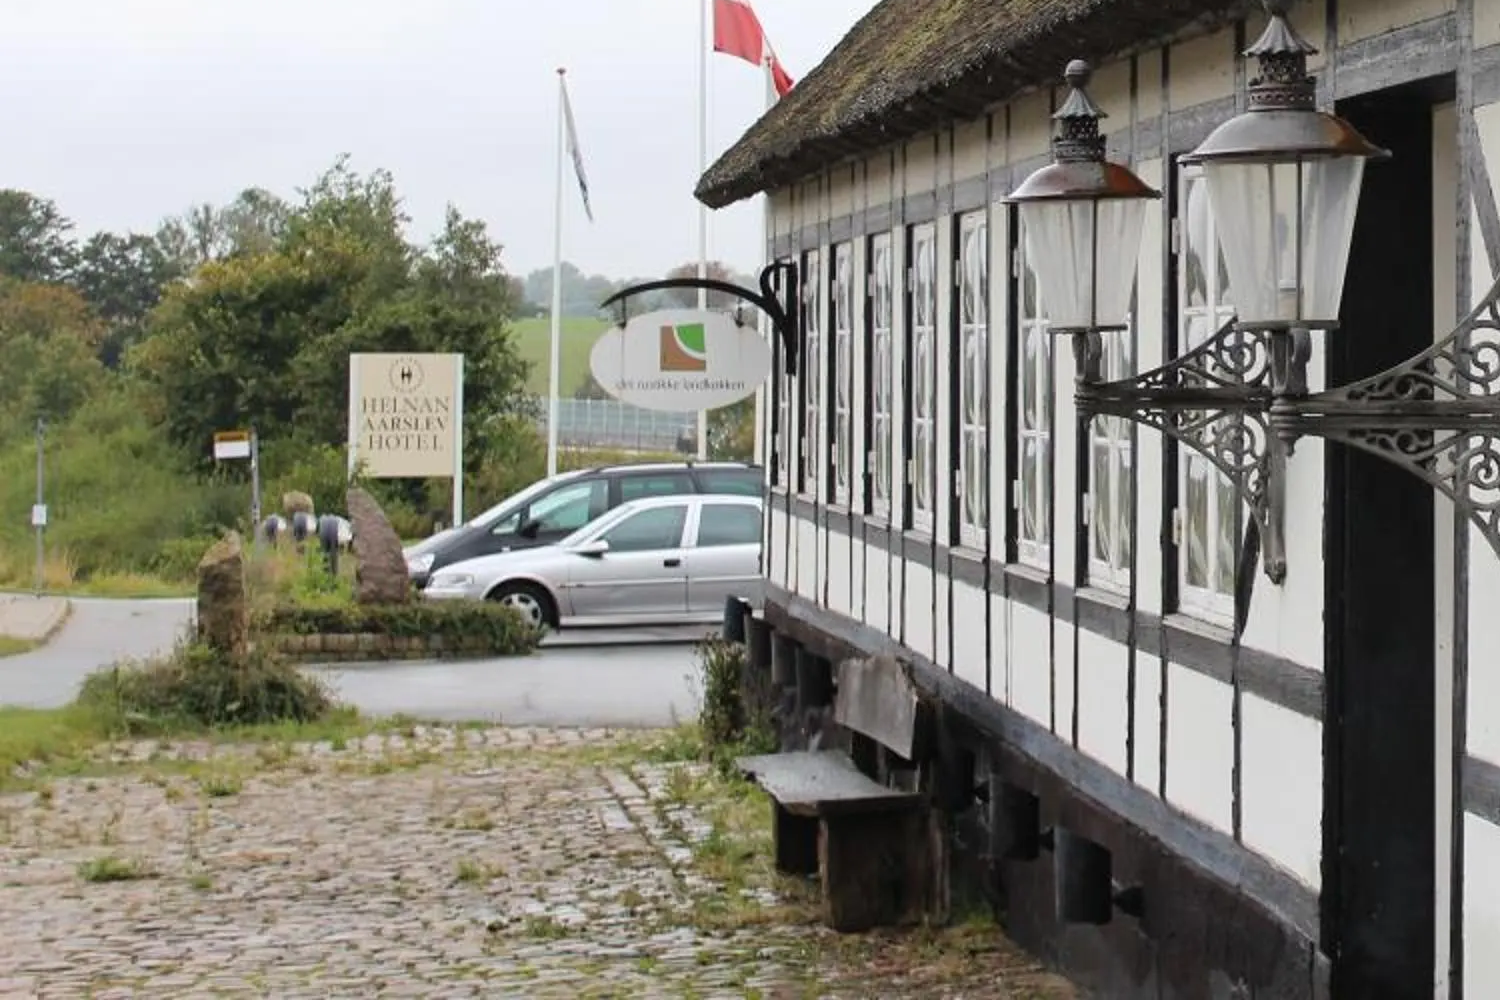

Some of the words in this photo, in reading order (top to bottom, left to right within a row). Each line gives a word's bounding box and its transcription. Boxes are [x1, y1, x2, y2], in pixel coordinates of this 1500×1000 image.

[362, 396, 450, 414] HELNAN
[362, 416, 449, 432] AARSLEV
[368, 433, 444, 451] HOTEL
